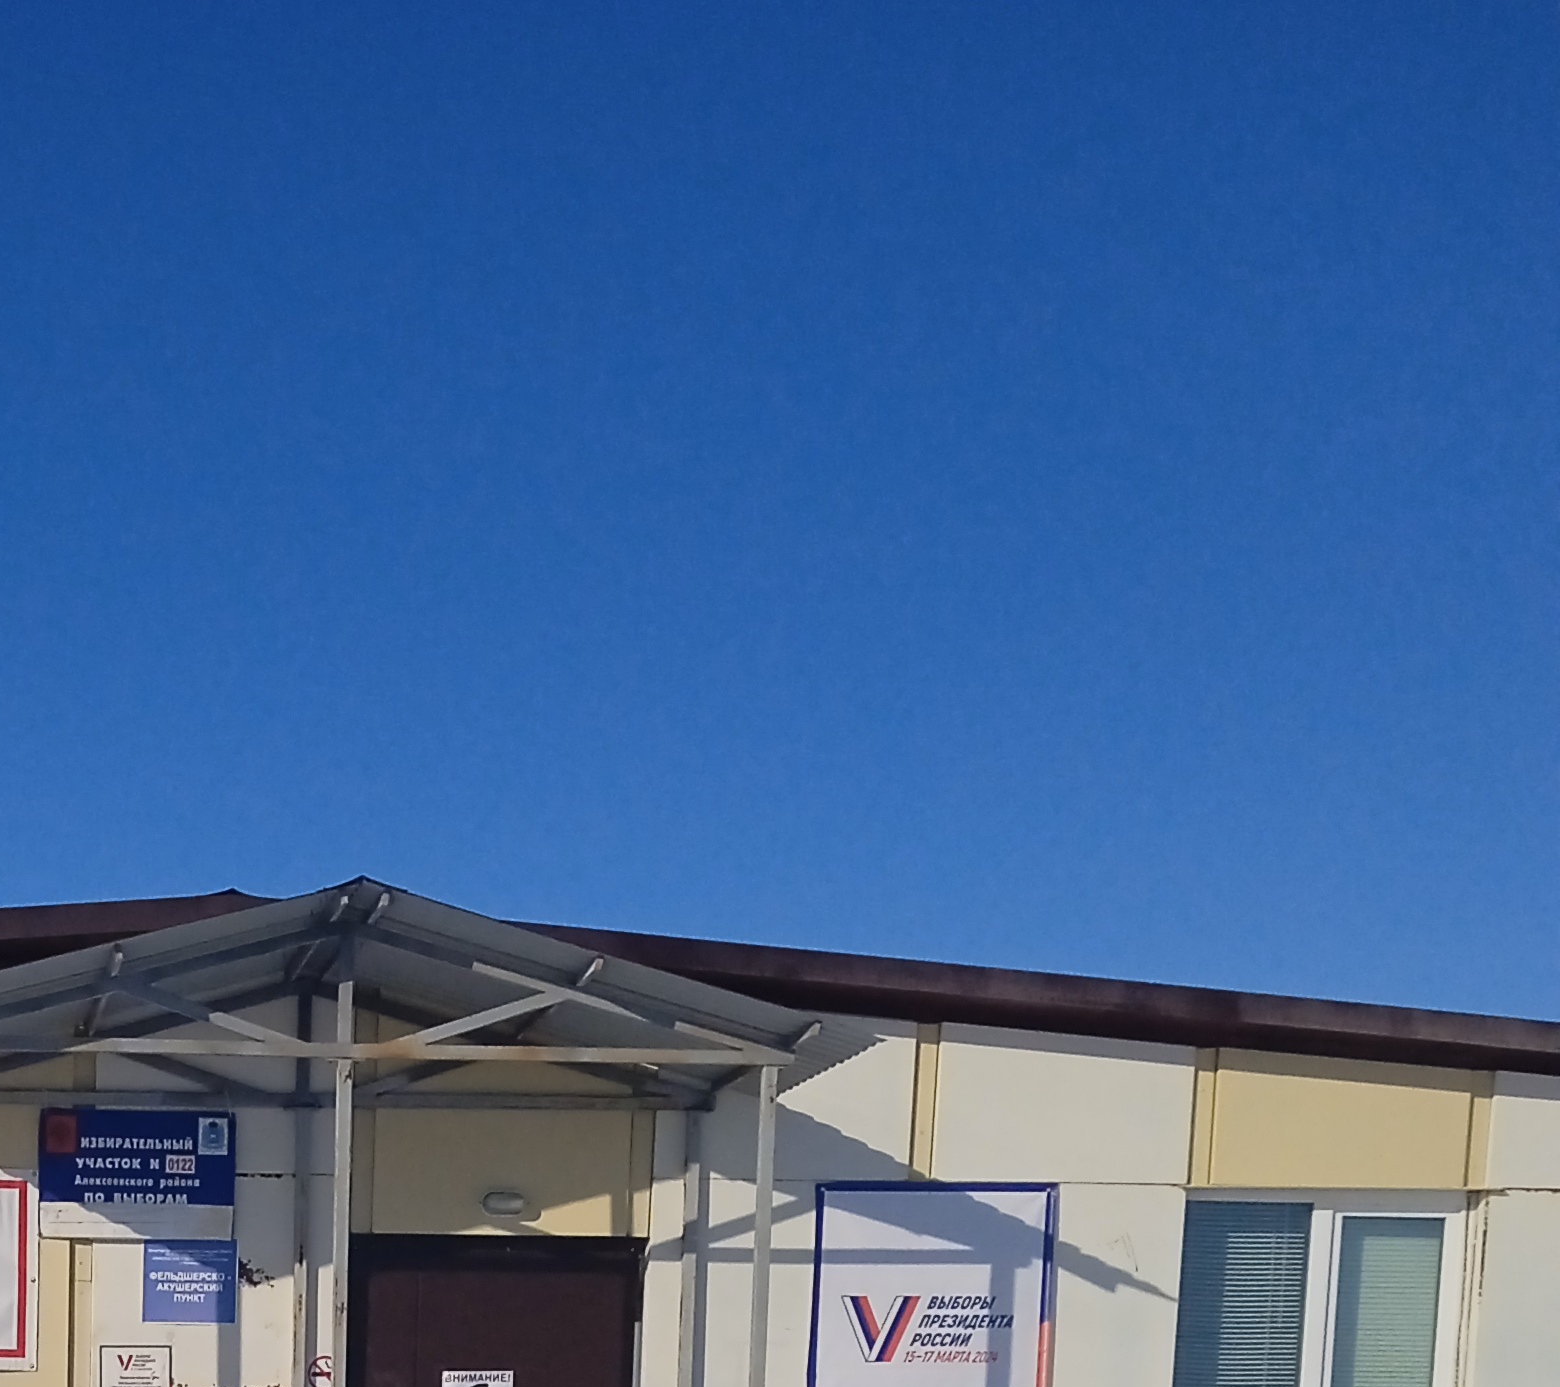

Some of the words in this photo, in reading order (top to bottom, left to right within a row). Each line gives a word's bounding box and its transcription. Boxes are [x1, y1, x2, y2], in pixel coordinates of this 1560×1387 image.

[80, 1137, 193, 1150] ИЗБИРАТЕЛЬНЫЙ
[75, 1157, 141, 1169] УЧАСТОК
[167, 1157, 194, 1172] 0122
[74, 1175, 154, 1187] Алексеевского
[160, 1176, 200, 1189] района
[84, 1192, 105, 1203] ПО
[113, 1193, 188, 1205] ВЫБОРАМ
[149, 1271, 225, 1282] ФЕЛЬДШЕРСКО
[173, 1293, 206, 1303] ПУНКТ
[927, 1295, 997, 1310] ВЫБОРЫ
[918, 1314, 1015, 1330] ПРЕЗИДЕНТА
[909, 1332, 973, 1347] РОССИИ
[934, 1351, 972, 1364] МАРТА
[972, 1351, 999, 1363] 2024
